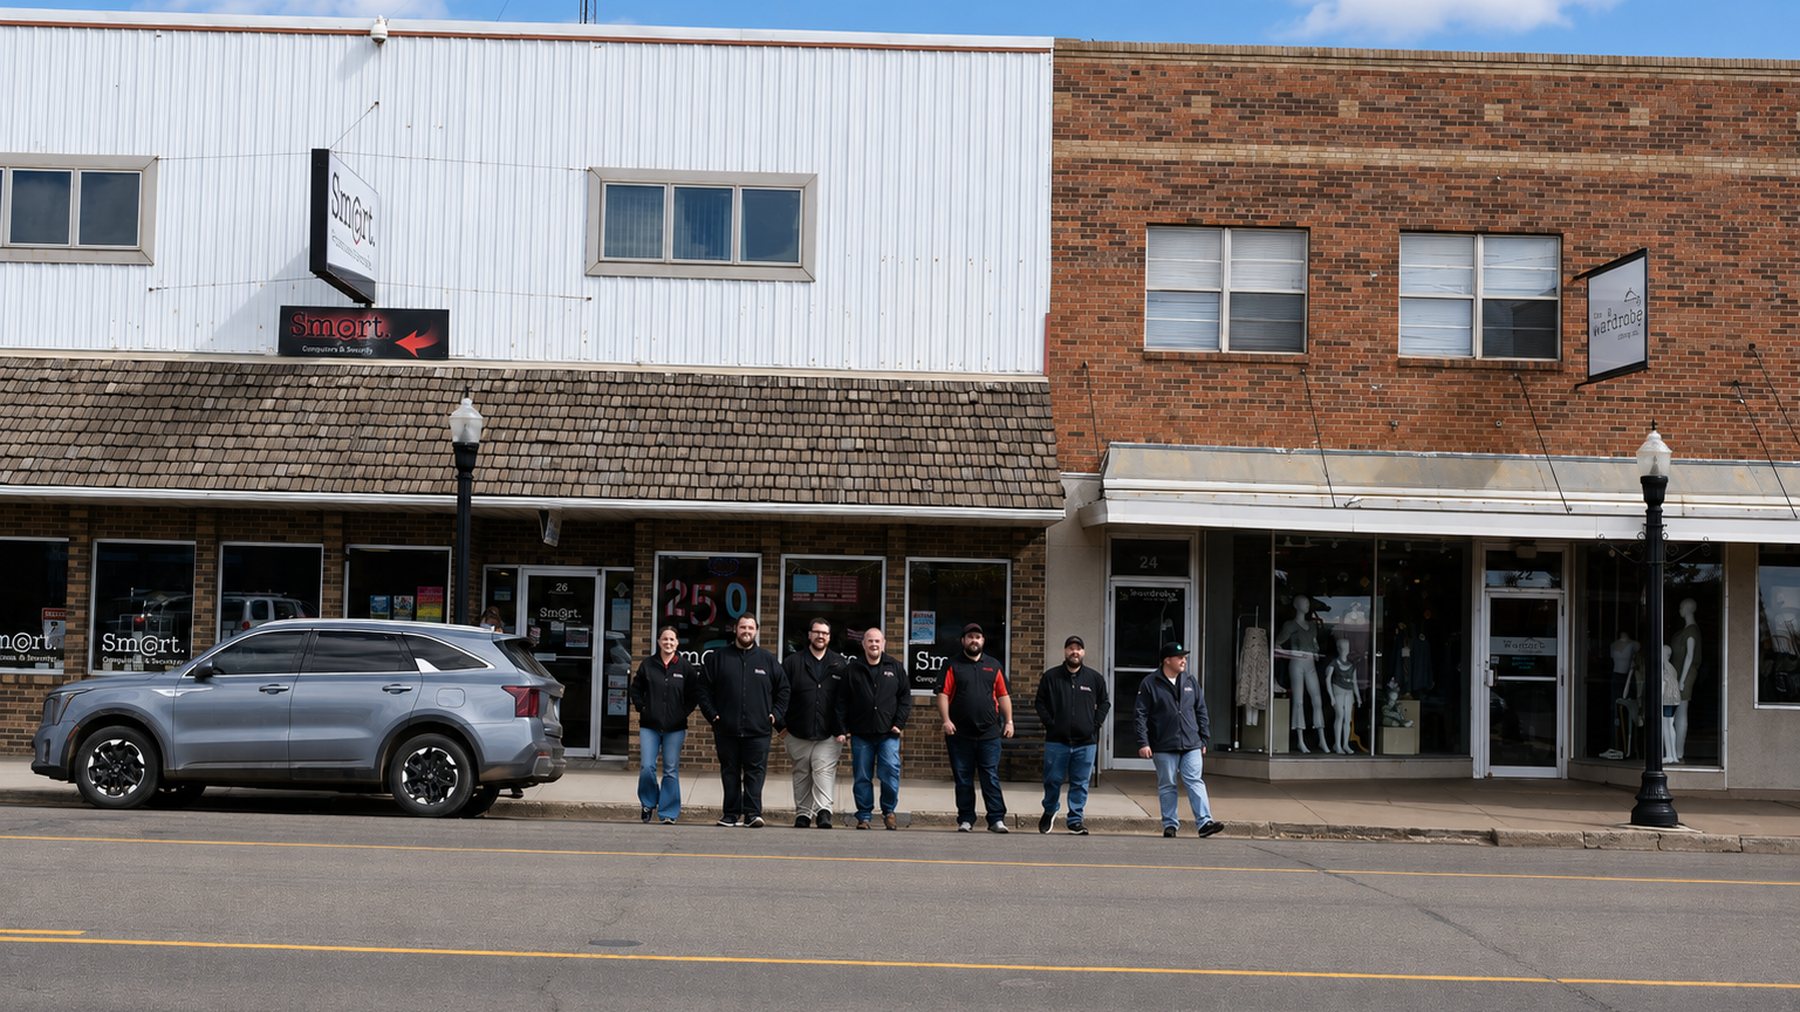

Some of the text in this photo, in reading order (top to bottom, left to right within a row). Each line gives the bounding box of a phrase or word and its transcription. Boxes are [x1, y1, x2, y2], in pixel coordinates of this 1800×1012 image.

[1139, 555, 1159, 569] 24
[1517, 569, 1533, 580] 22
[555, 583, 568, 592] 26
[916, 650, 948, 670] Sm
